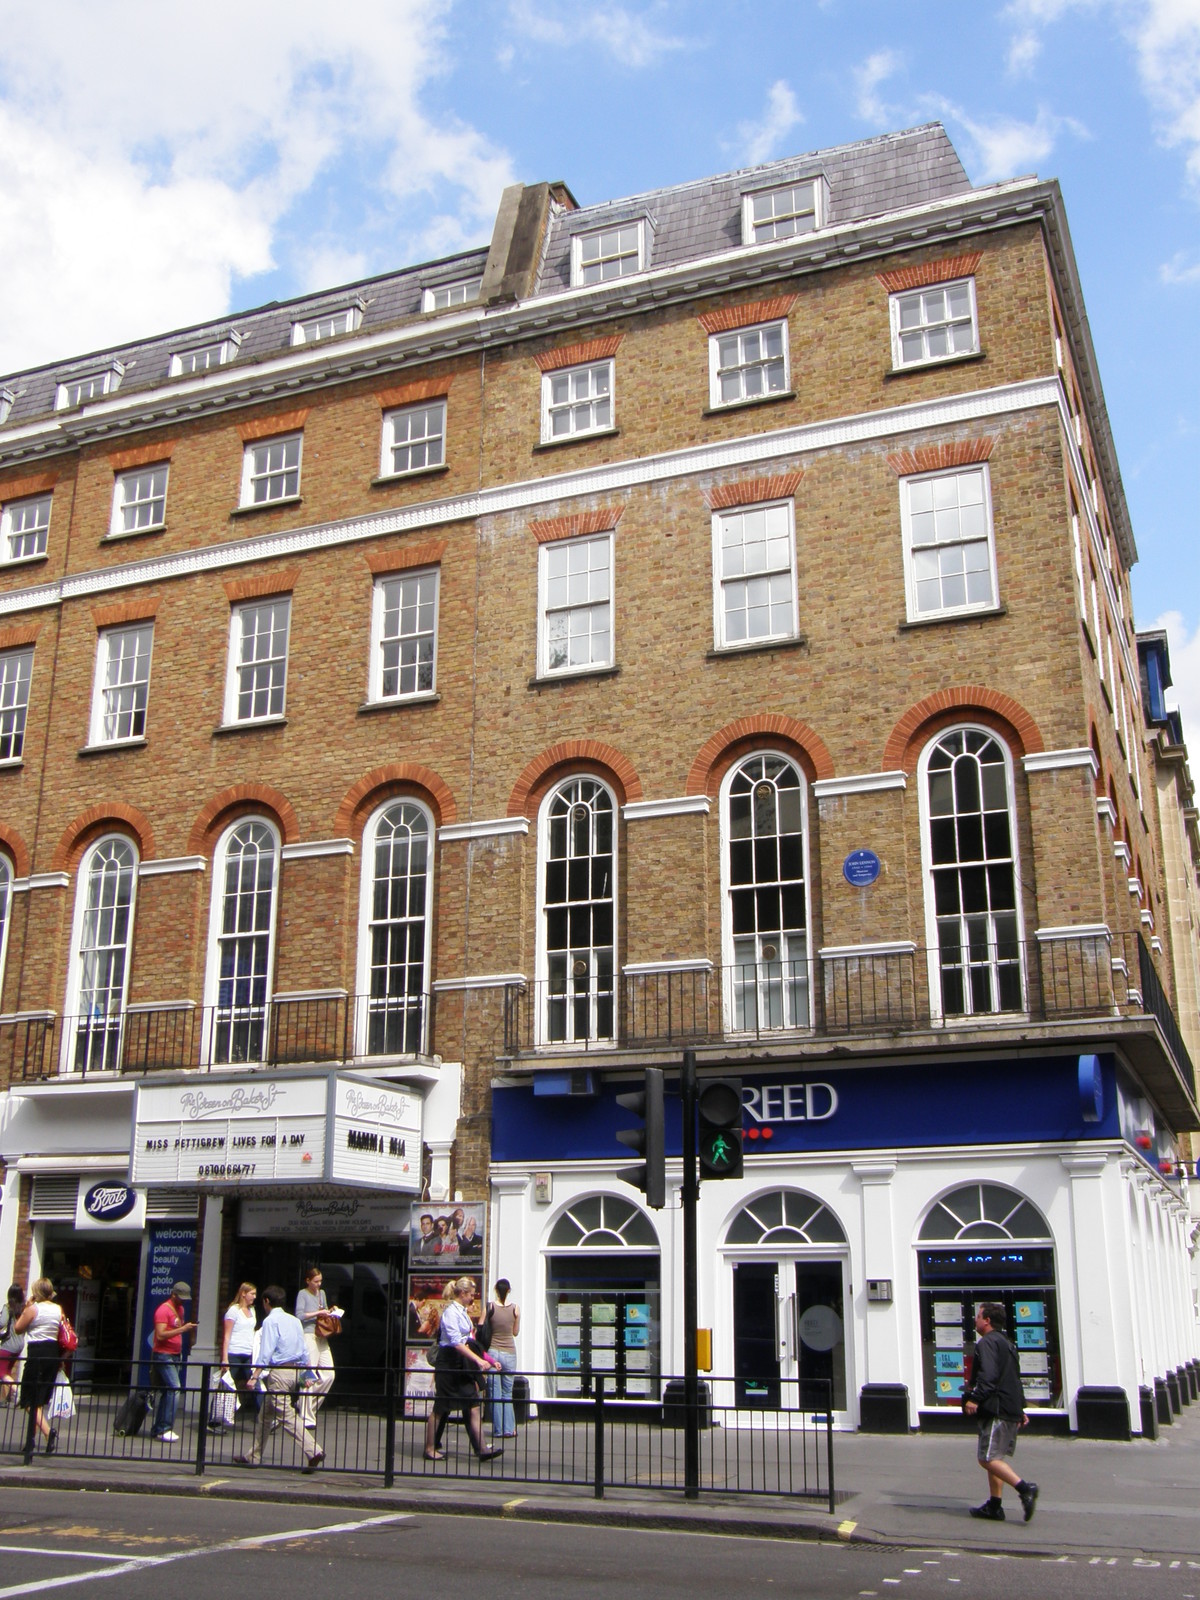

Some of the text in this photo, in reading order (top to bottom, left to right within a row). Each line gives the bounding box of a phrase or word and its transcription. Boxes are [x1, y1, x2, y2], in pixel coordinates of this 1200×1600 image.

[180, 1092, 196, 1113] The
[189, 1091, 222, 1119] Screen
[231, 1088, 263, 1113] Baker
[742, 1083, 838, 1122] REED
[146, 1134, 306, 1149] MISS PETTIGREW LIVES FOR A DAY
[347, 1129, 406, 1157] MAMMA MIA
[88, 1187, 128, 1212] Boots
[155, 1229, 198, 1239] welcome
[153, 1245, 191, 1255] pharmacy
[153, 1255, 179, 1265] beauty
[152, 1265, 171, 1275] baby
[151, 1276, 174, 1286] photo
[150, 1286, 173, 1295] electr
